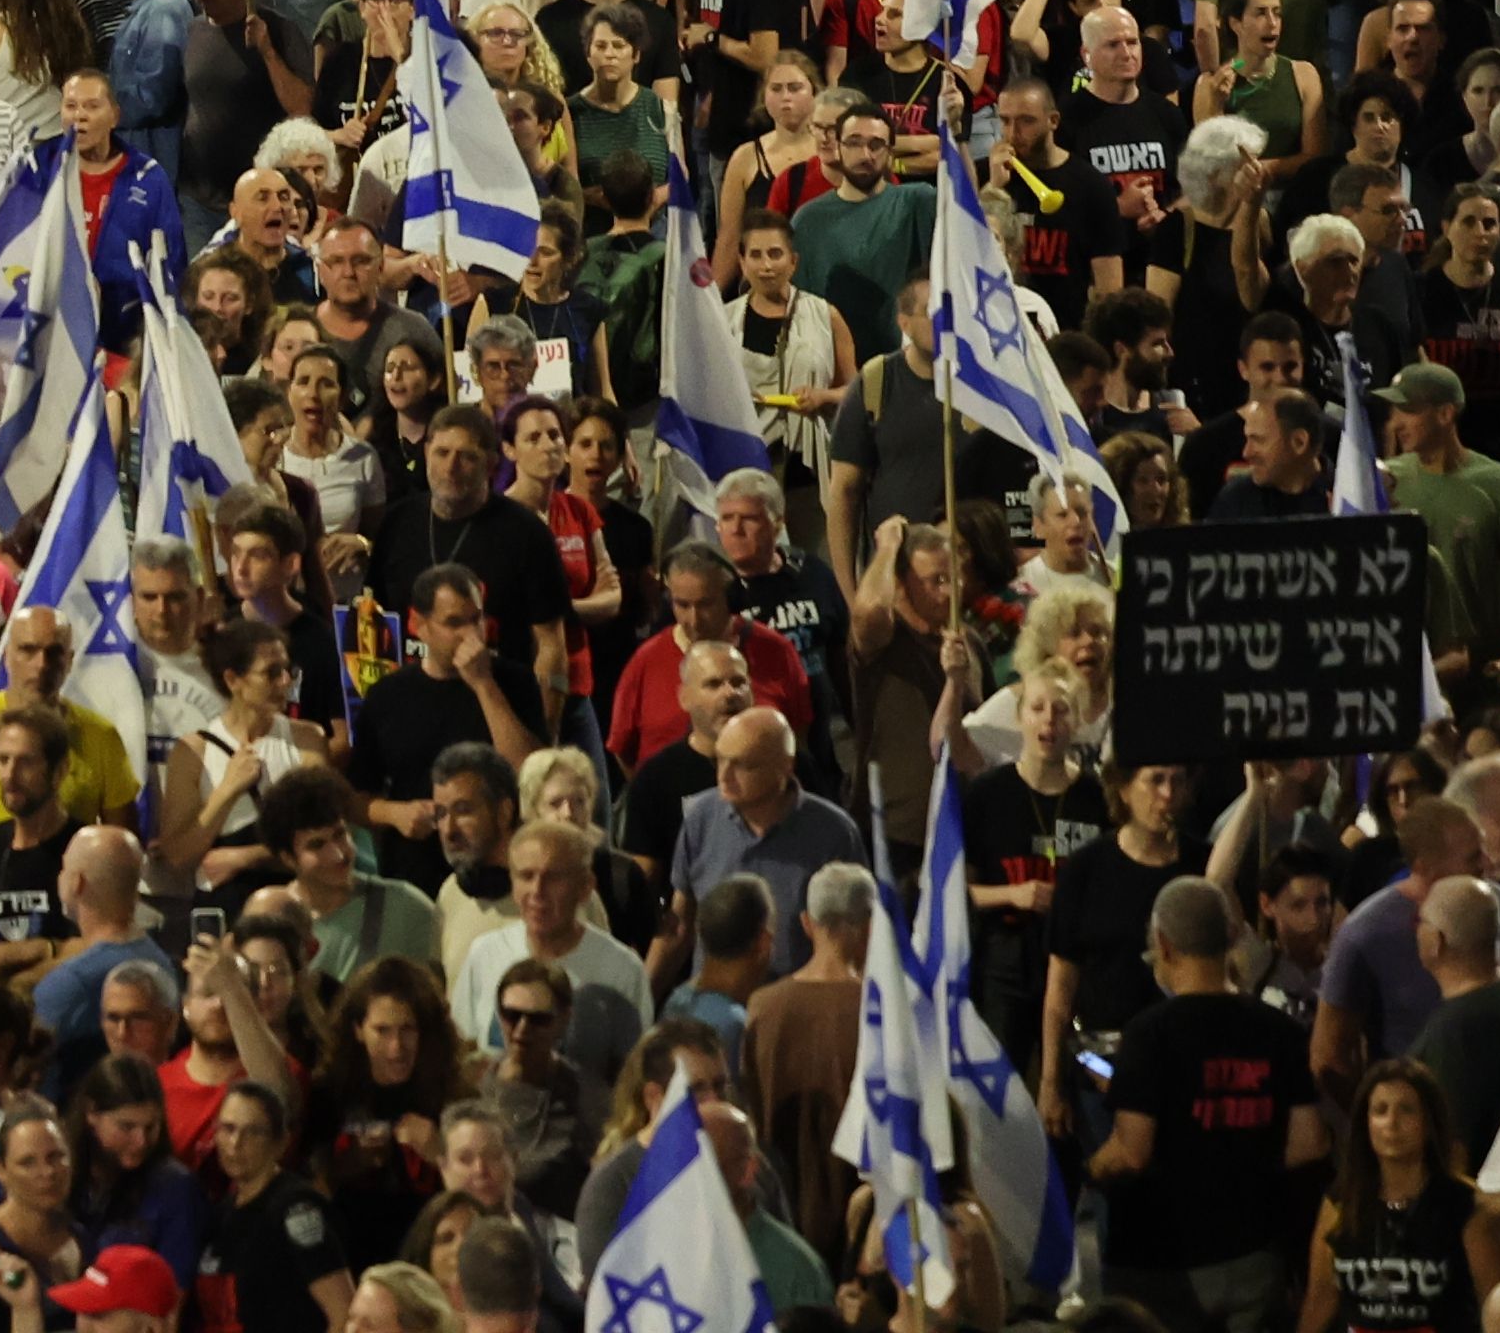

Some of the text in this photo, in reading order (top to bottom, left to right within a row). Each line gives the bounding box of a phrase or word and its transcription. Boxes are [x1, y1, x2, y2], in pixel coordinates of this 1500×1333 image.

[1088, 141, 1167, 175] האשם
[1137, 526, 1412, 619] לא אשתוק כי
[1141, 617, 1402, 673] ארצי שינתה
[1221, 687, 1398, 738] את פניה
